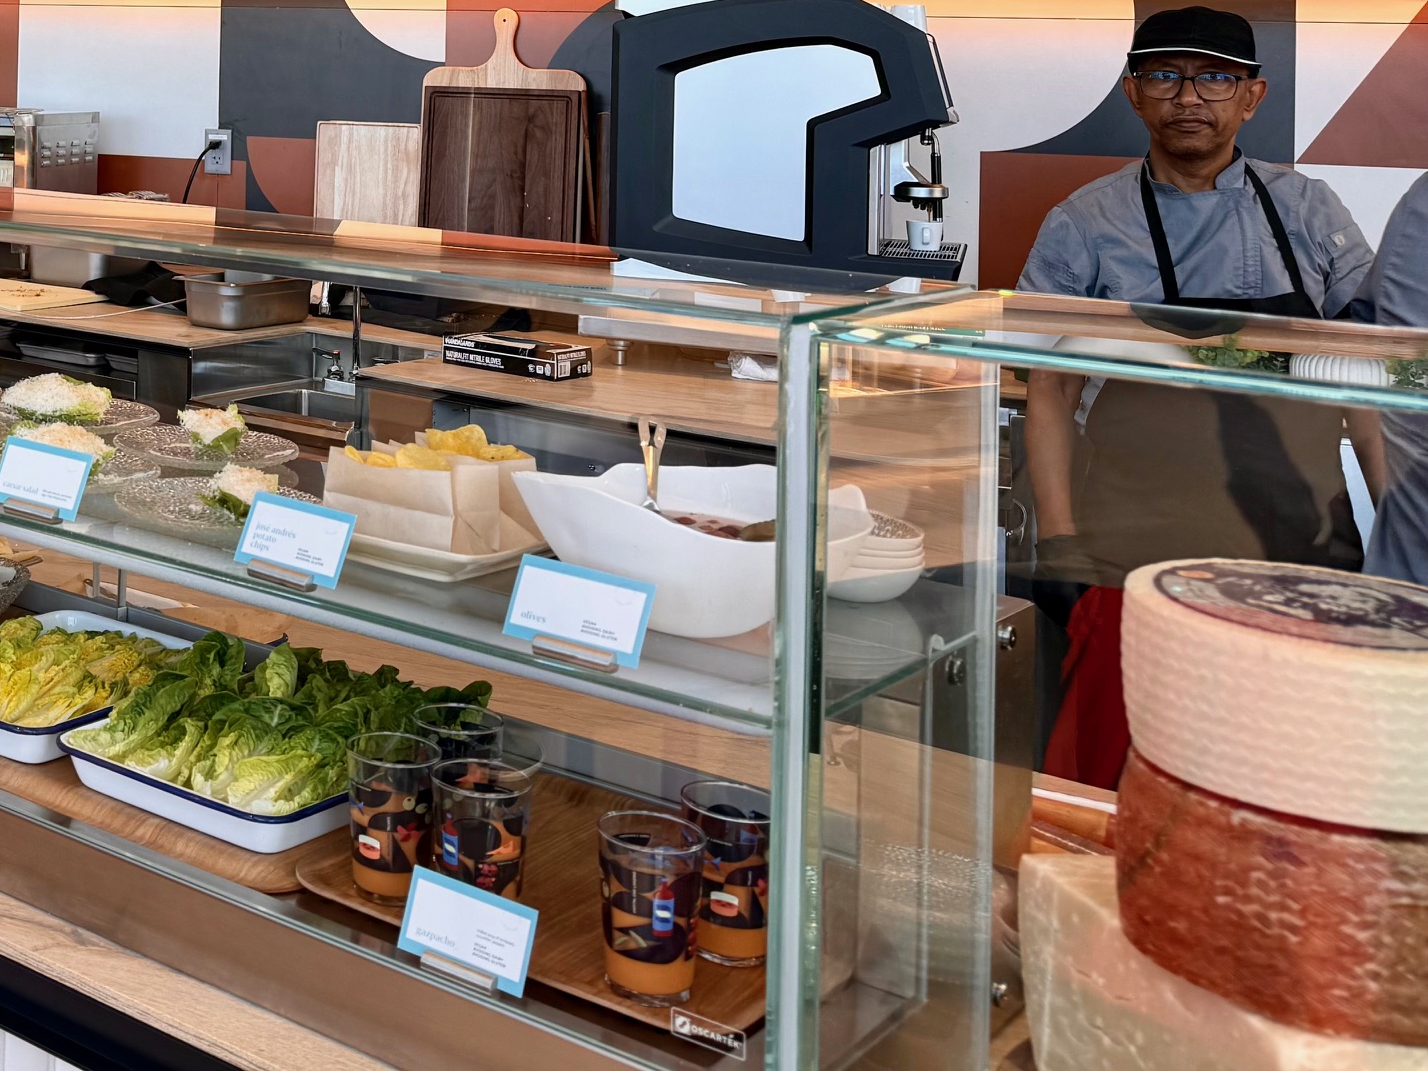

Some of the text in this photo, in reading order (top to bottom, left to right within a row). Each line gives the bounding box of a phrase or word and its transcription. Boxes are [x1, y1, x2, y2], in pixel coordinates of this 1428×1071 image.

[2, 481, 22, 491] caesar
[23, 485, 39, 495] salad
[255, 521, 296, 539] josé andrés
[252, 532, 277, 544] potato
[249, 540, 270, 552] chips
[520, 610, 547, 624] olives
[415, 926, 456, 948] gazpacho
